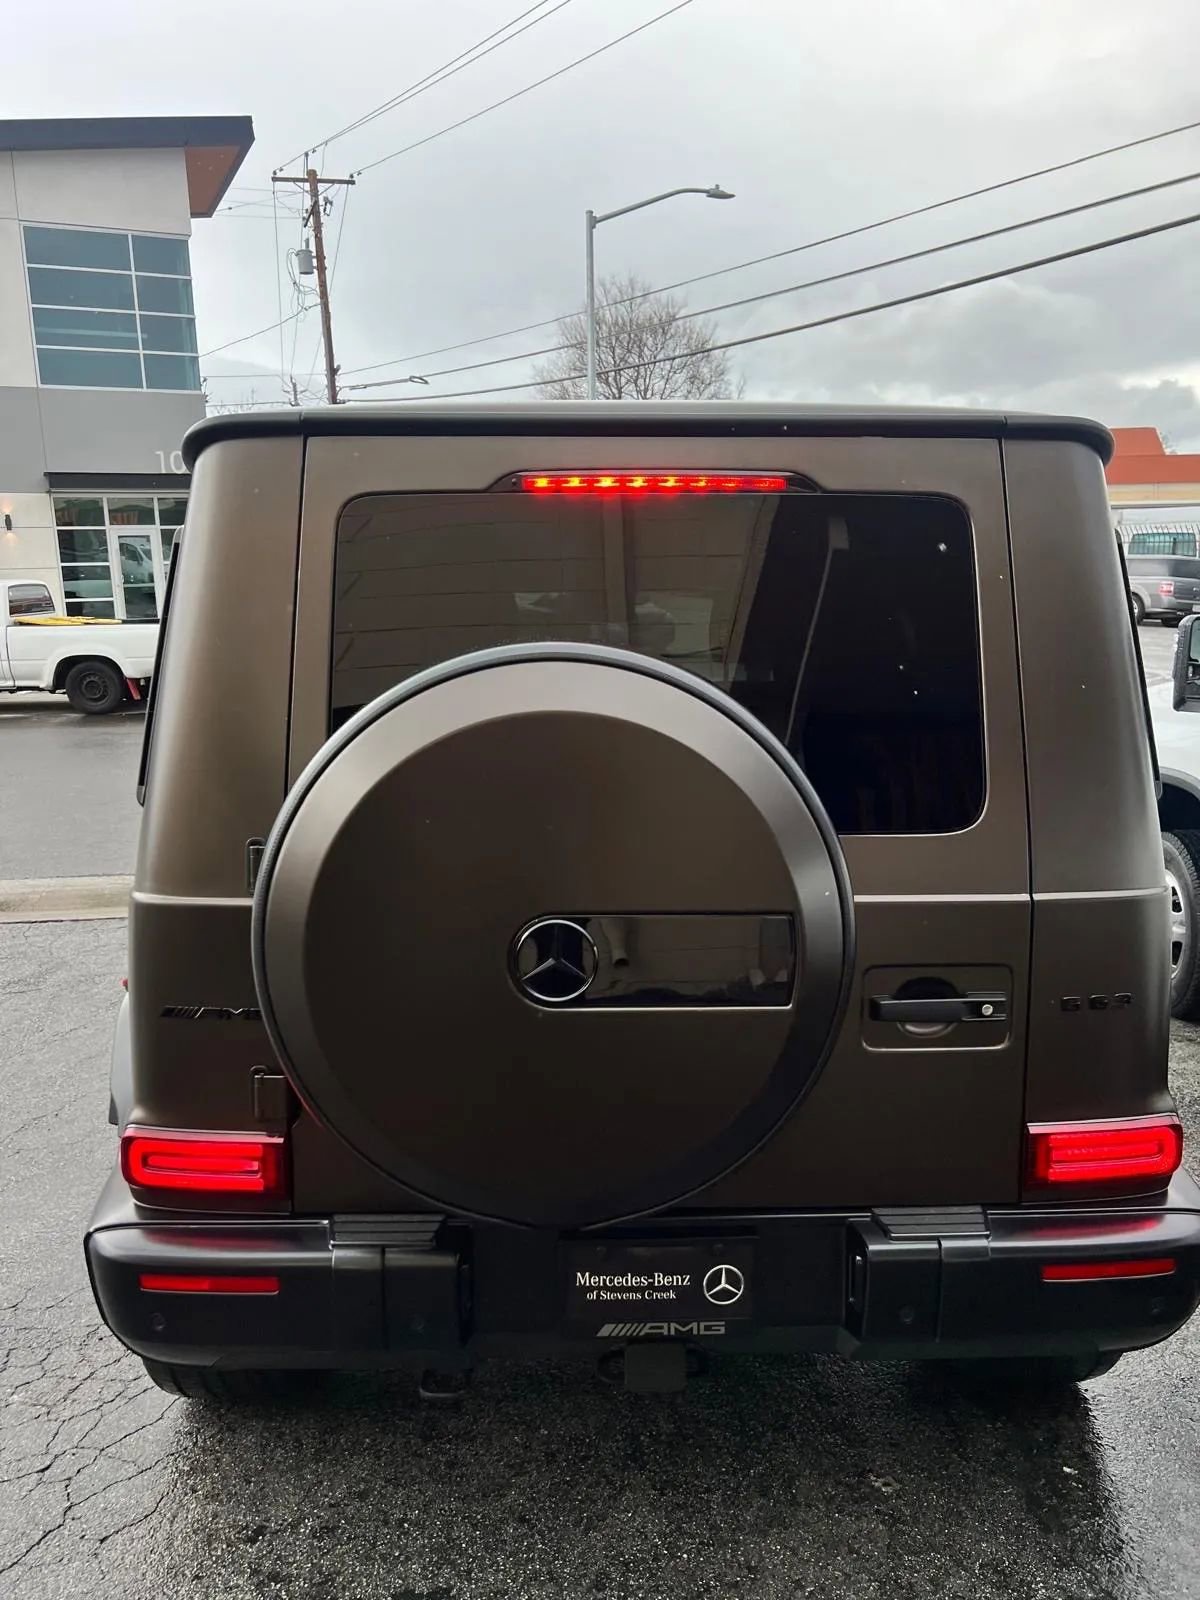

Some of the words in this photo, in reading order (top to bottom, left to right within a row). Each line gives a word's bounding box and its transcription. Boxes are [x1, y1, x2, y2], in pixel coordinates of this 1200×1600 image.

[576, 1272, 691, 1287] Mercedes-Benz
[586, 1290, 598, 1300] of
[599, 1290, 642, 1301] Stevens
[644, 1289, 677, 1300] Creek
[639, 1321, 726, 1336] AMG
